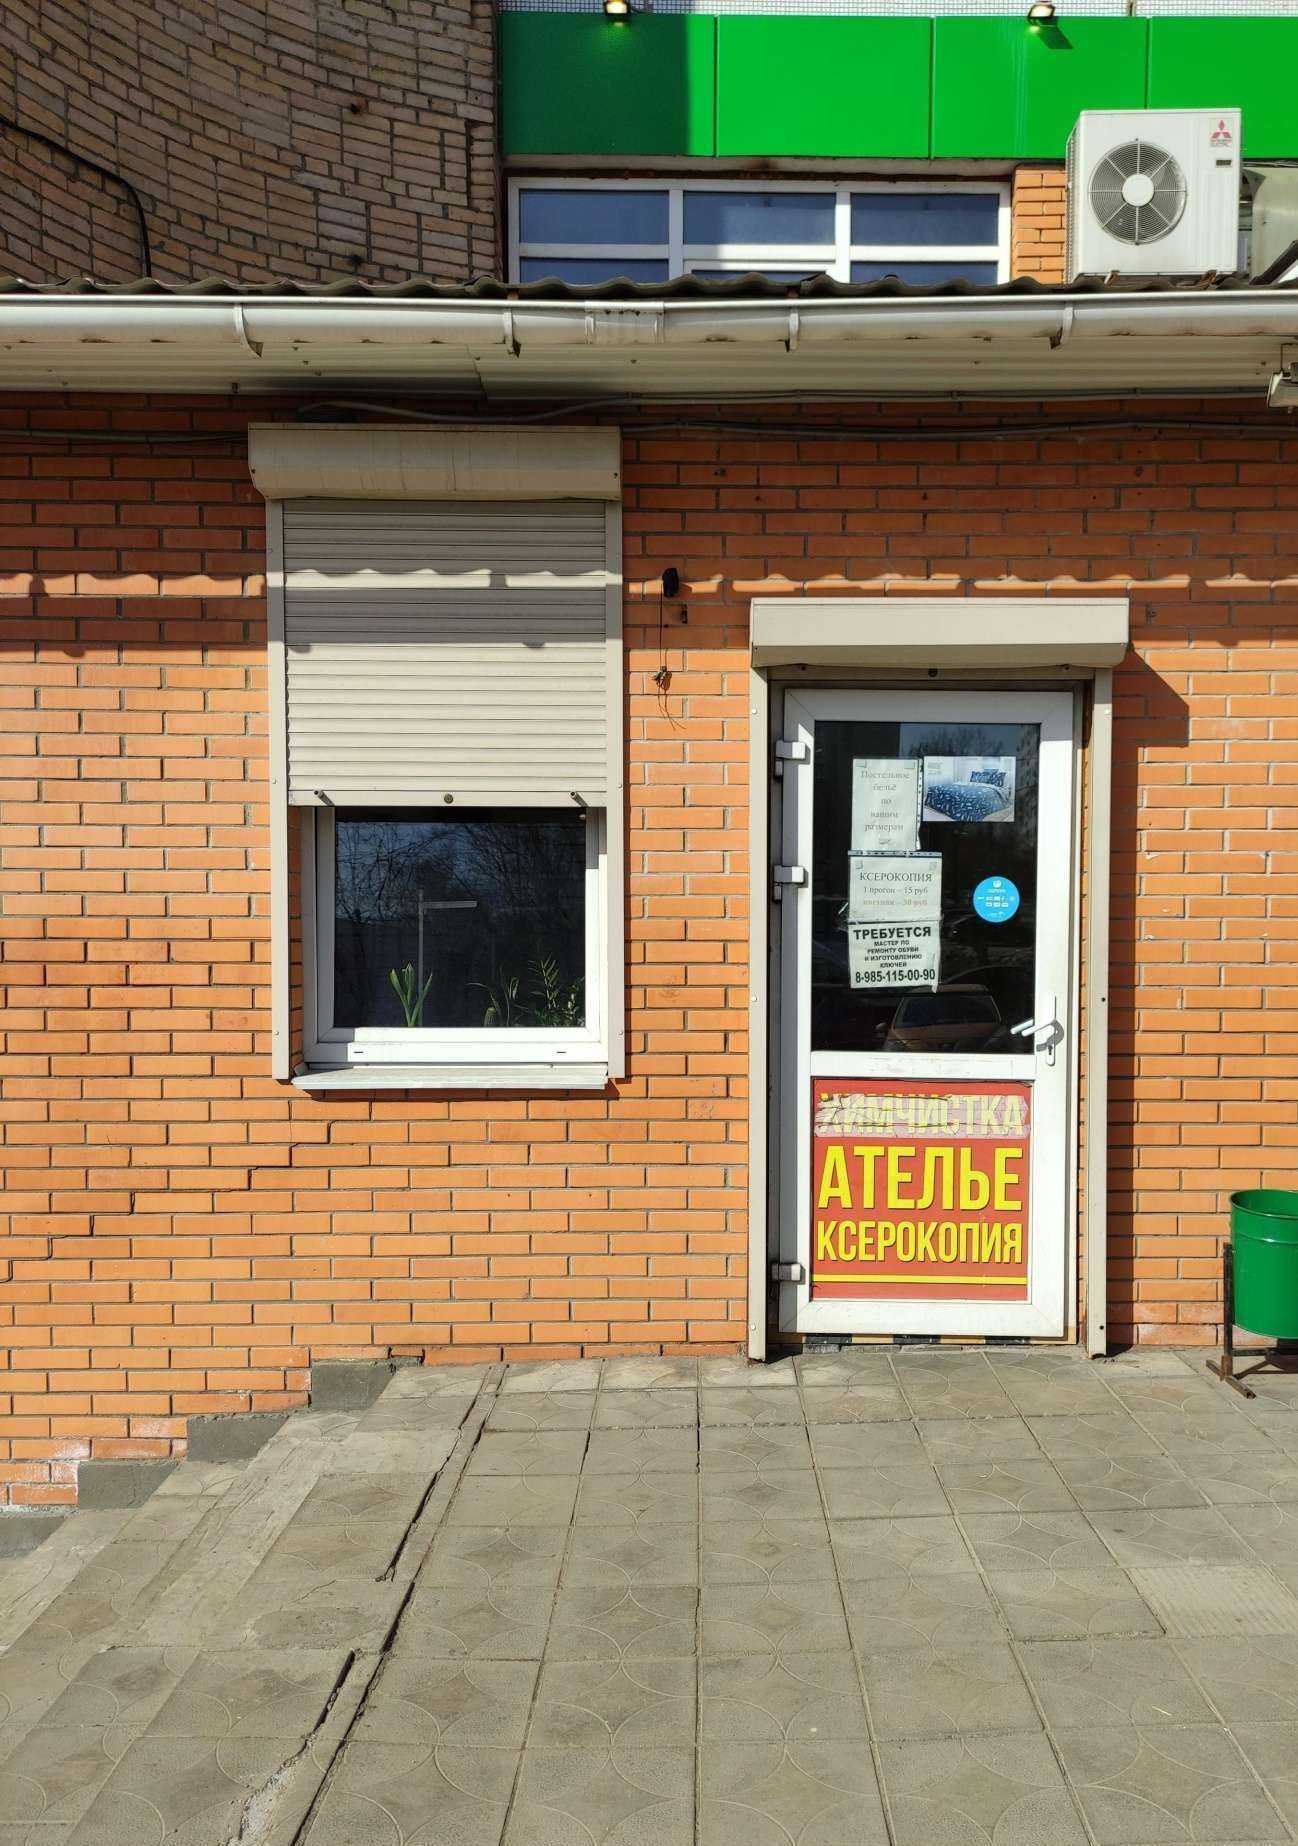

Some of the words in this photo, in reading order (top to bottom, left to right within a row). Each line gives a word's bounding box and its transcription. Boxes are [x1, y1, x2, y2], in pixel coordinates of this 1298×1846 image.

[860, 871, 932, 882] КСЕРОКОПИЯ
[914, 886, 928, 896] руб
[853, 926, 931, 940] ТРЕБУЕТСЯ
[855, 968, 936, 984] 8-985-115-00-90
[817, 1145, 1023, 1211] АТЕЛЬЕ
[817, 1220, 1023, 1264] КСЕРОКОПИЯ
